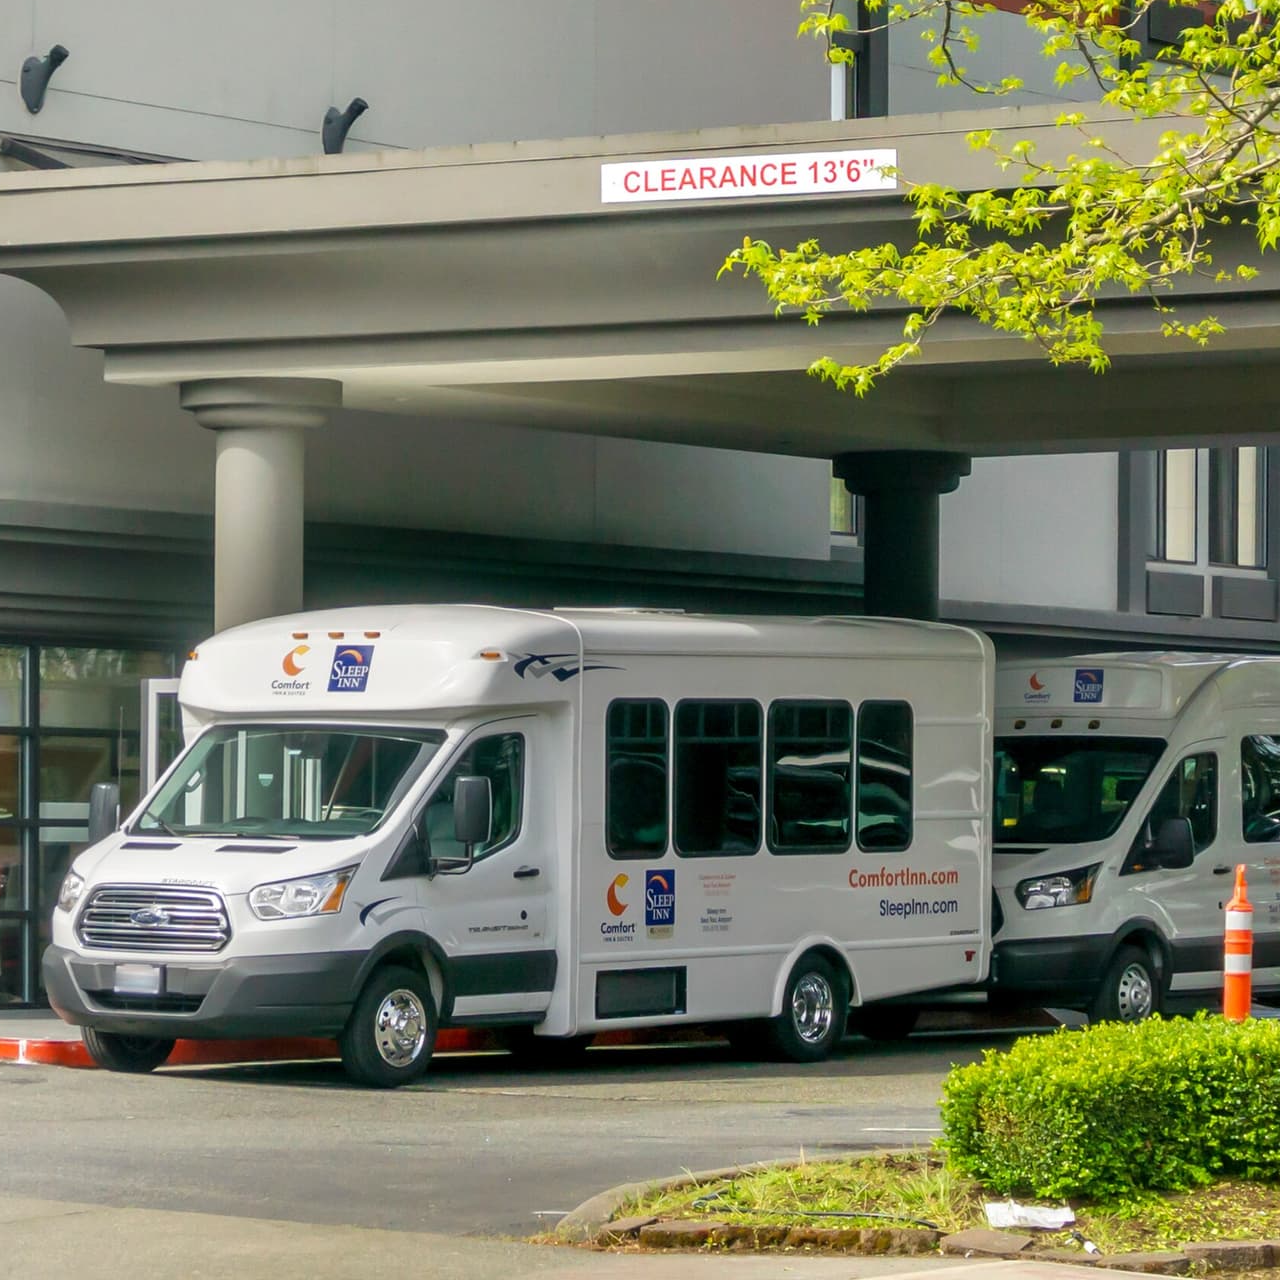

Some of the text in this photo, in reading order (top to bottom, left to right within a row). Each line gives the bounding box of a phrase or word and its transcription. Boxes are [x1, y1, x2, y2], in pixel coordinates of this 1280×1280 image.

[623, 158, 876, 194] CLEARANCE 13'6"
[331, 660, 369, 680] SLEEP
[271, 679, 310, 690] Comfort
[337, 678, 361, 689] INN
[848, 866, 959, 888] ComfortInn.com
[646, 888, 675, 911] SLEEP
[879, 898, 959, 919] SleepInn.com
[653, 908, 671, 921] INN
[600, 921, 636, 935] Comfort
